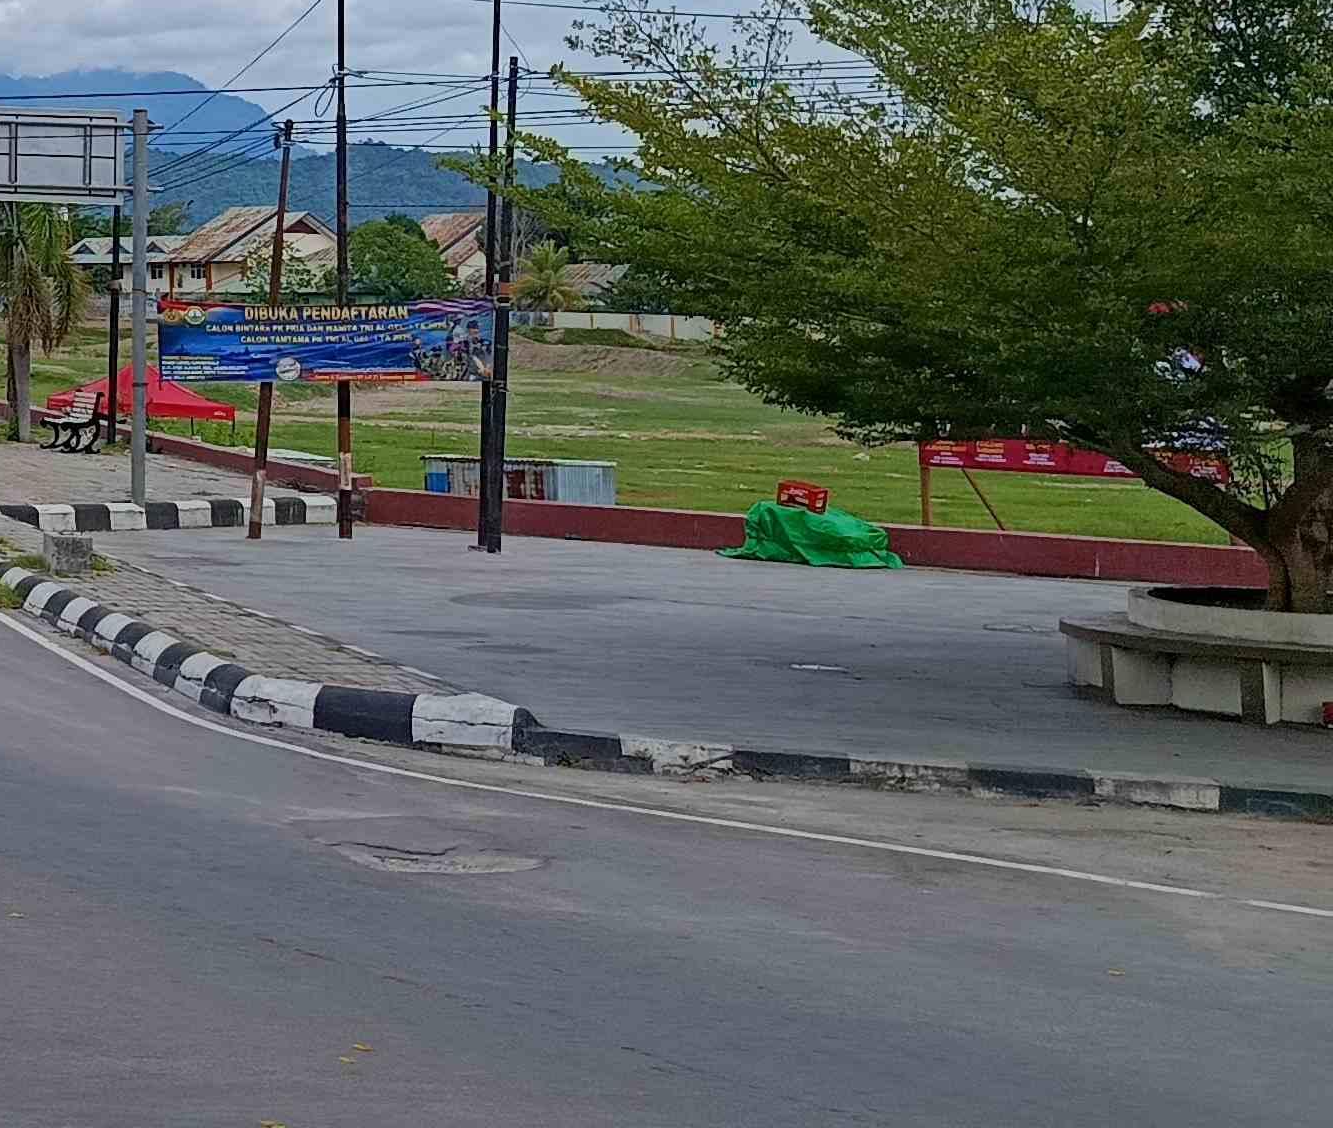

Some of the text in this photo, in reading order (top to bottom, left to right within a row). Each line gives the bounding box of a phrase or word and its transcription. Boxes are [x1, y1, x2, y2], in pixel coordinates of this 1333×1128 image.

[244, 306, 409, 320] DIBUKA PENDAFTARAN
[307, 324, 323, 332] DAN
[241, 336, 268, 344] CALON
